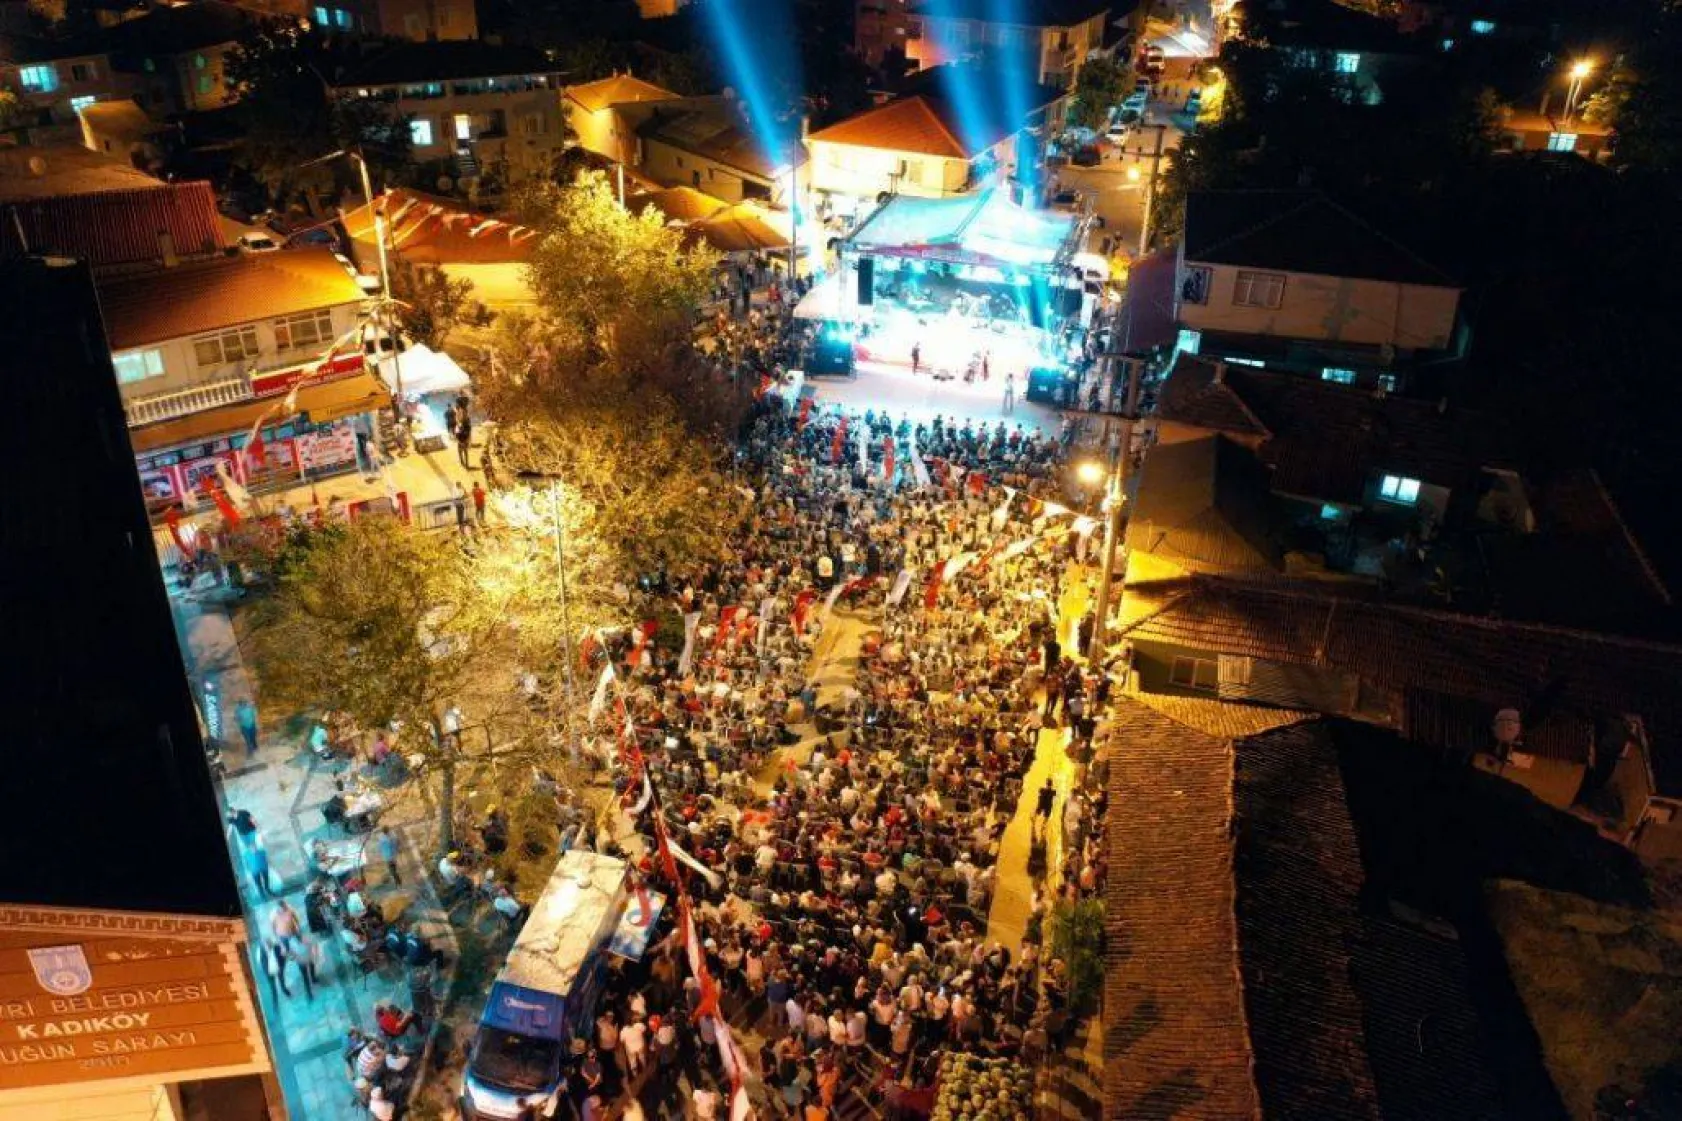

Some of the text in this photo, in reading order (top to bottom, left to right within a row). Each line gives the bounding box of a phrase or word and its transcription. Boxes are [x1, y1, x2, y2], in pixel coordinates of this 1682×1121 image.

[51, 984, 209, 1014] BELEDİYESİ
[16, 1012, 150, 1040] KADIKÖY
[92, 1032, 196, 1054] SARAYI
